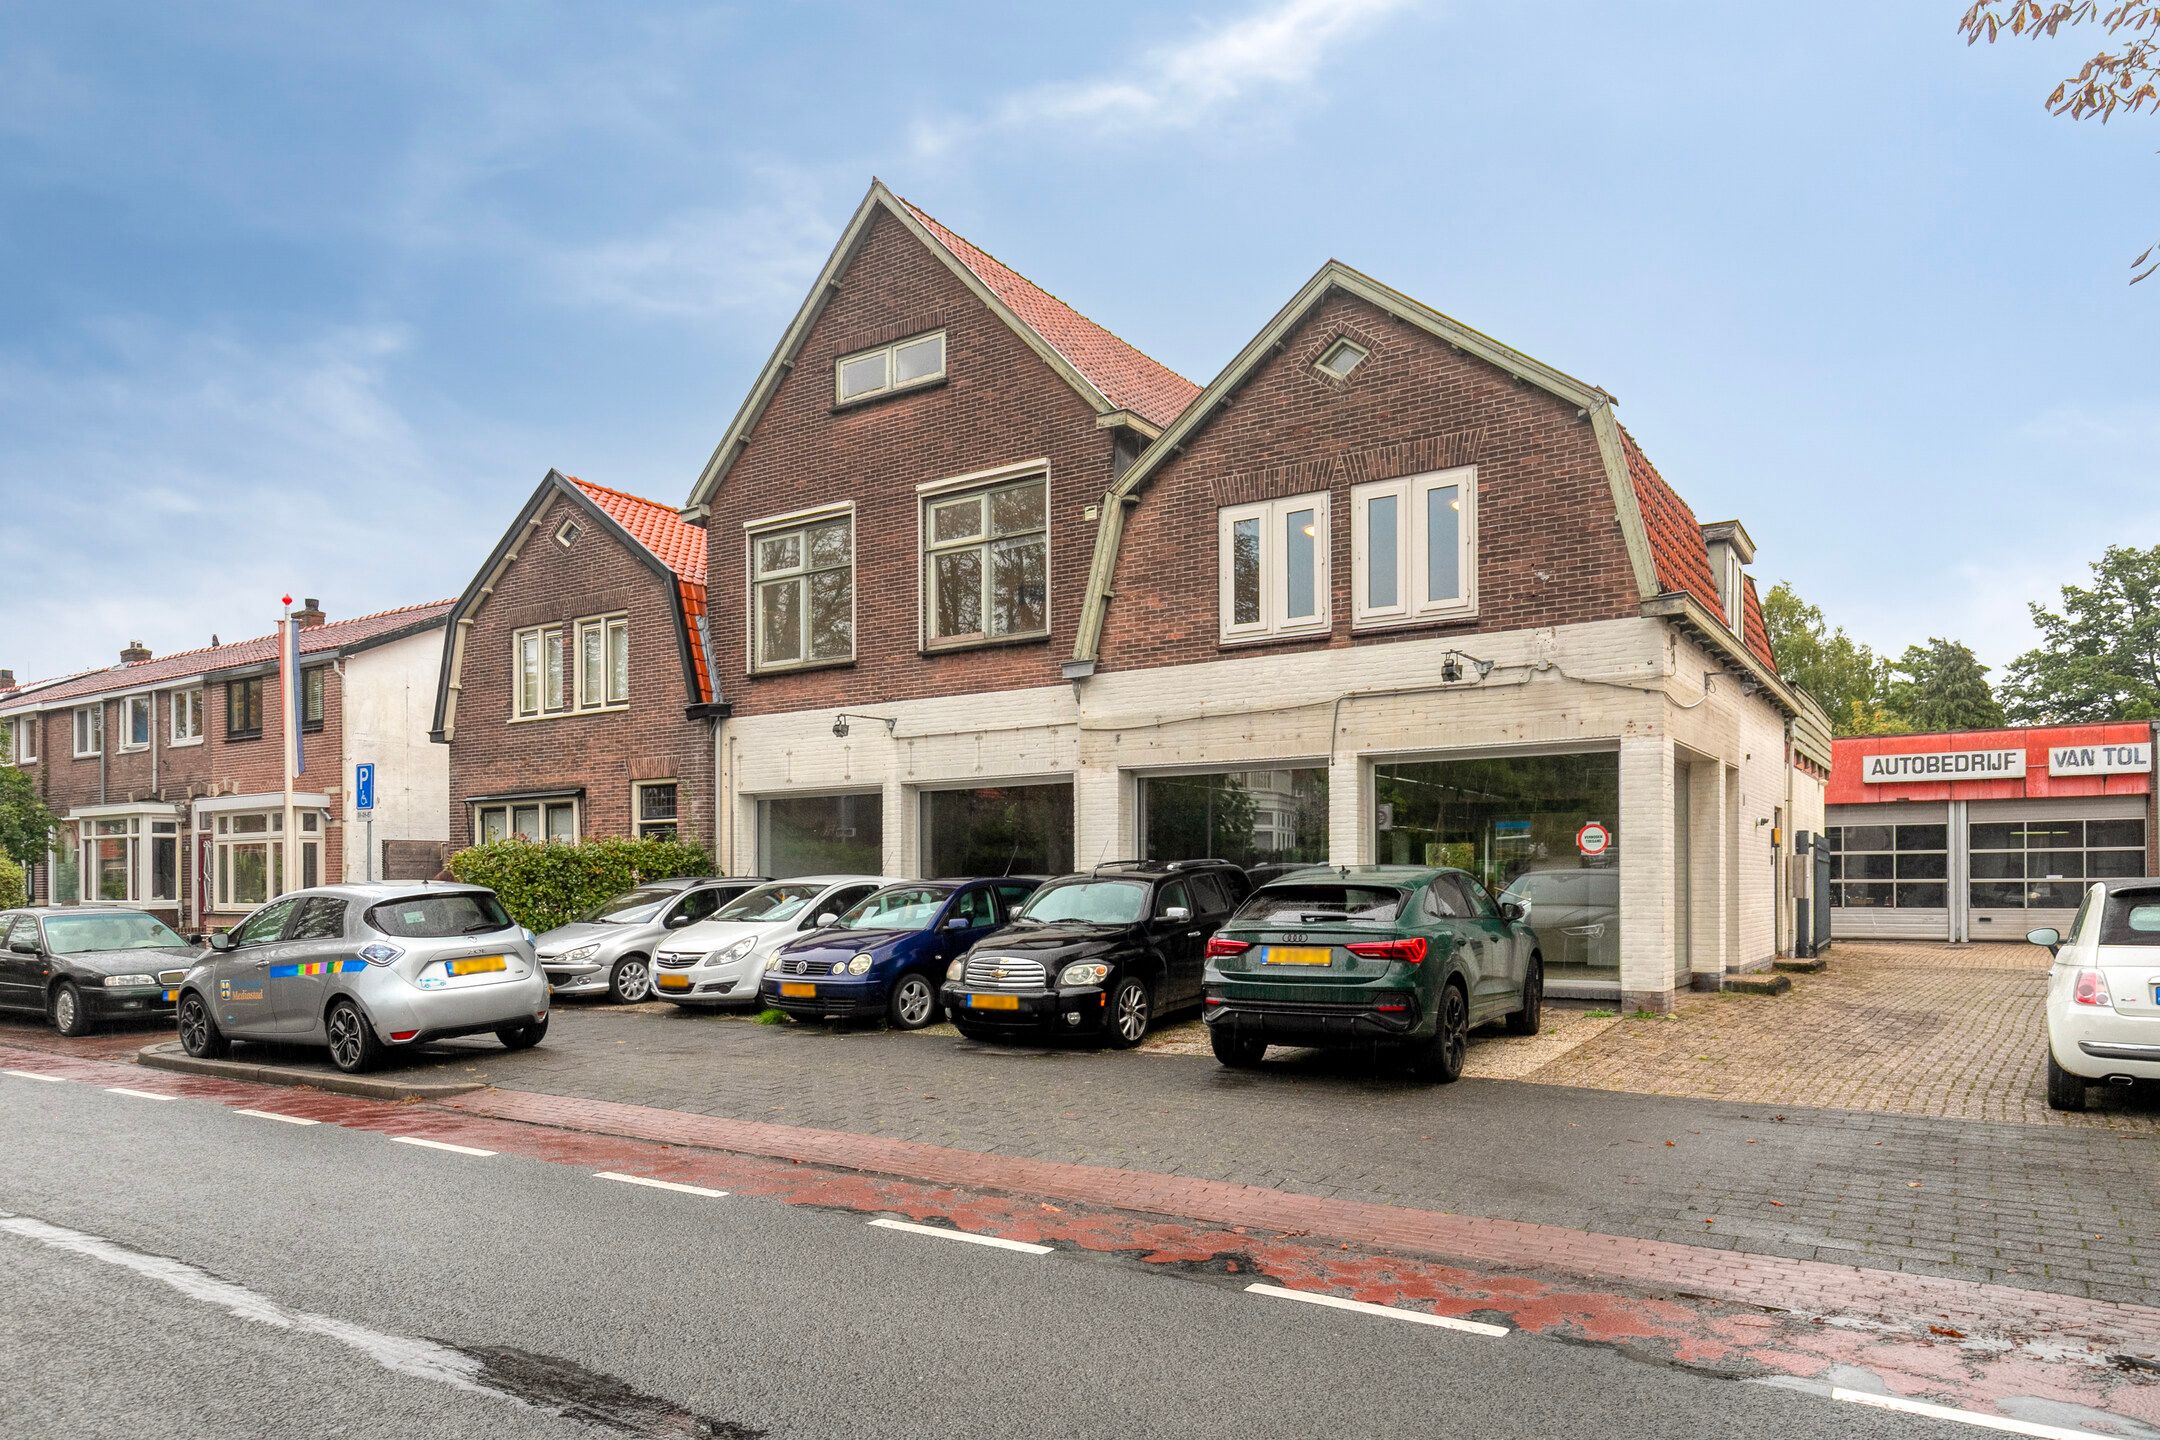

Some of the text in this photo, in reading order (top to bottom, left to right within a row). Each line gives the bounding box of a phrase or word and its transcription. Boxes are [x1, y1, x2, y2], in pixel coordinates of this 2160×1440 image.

[1871, 746, 2148, 775] AUTOBEDRIJF VAN TOL
[359, 767, 369, 790] P
